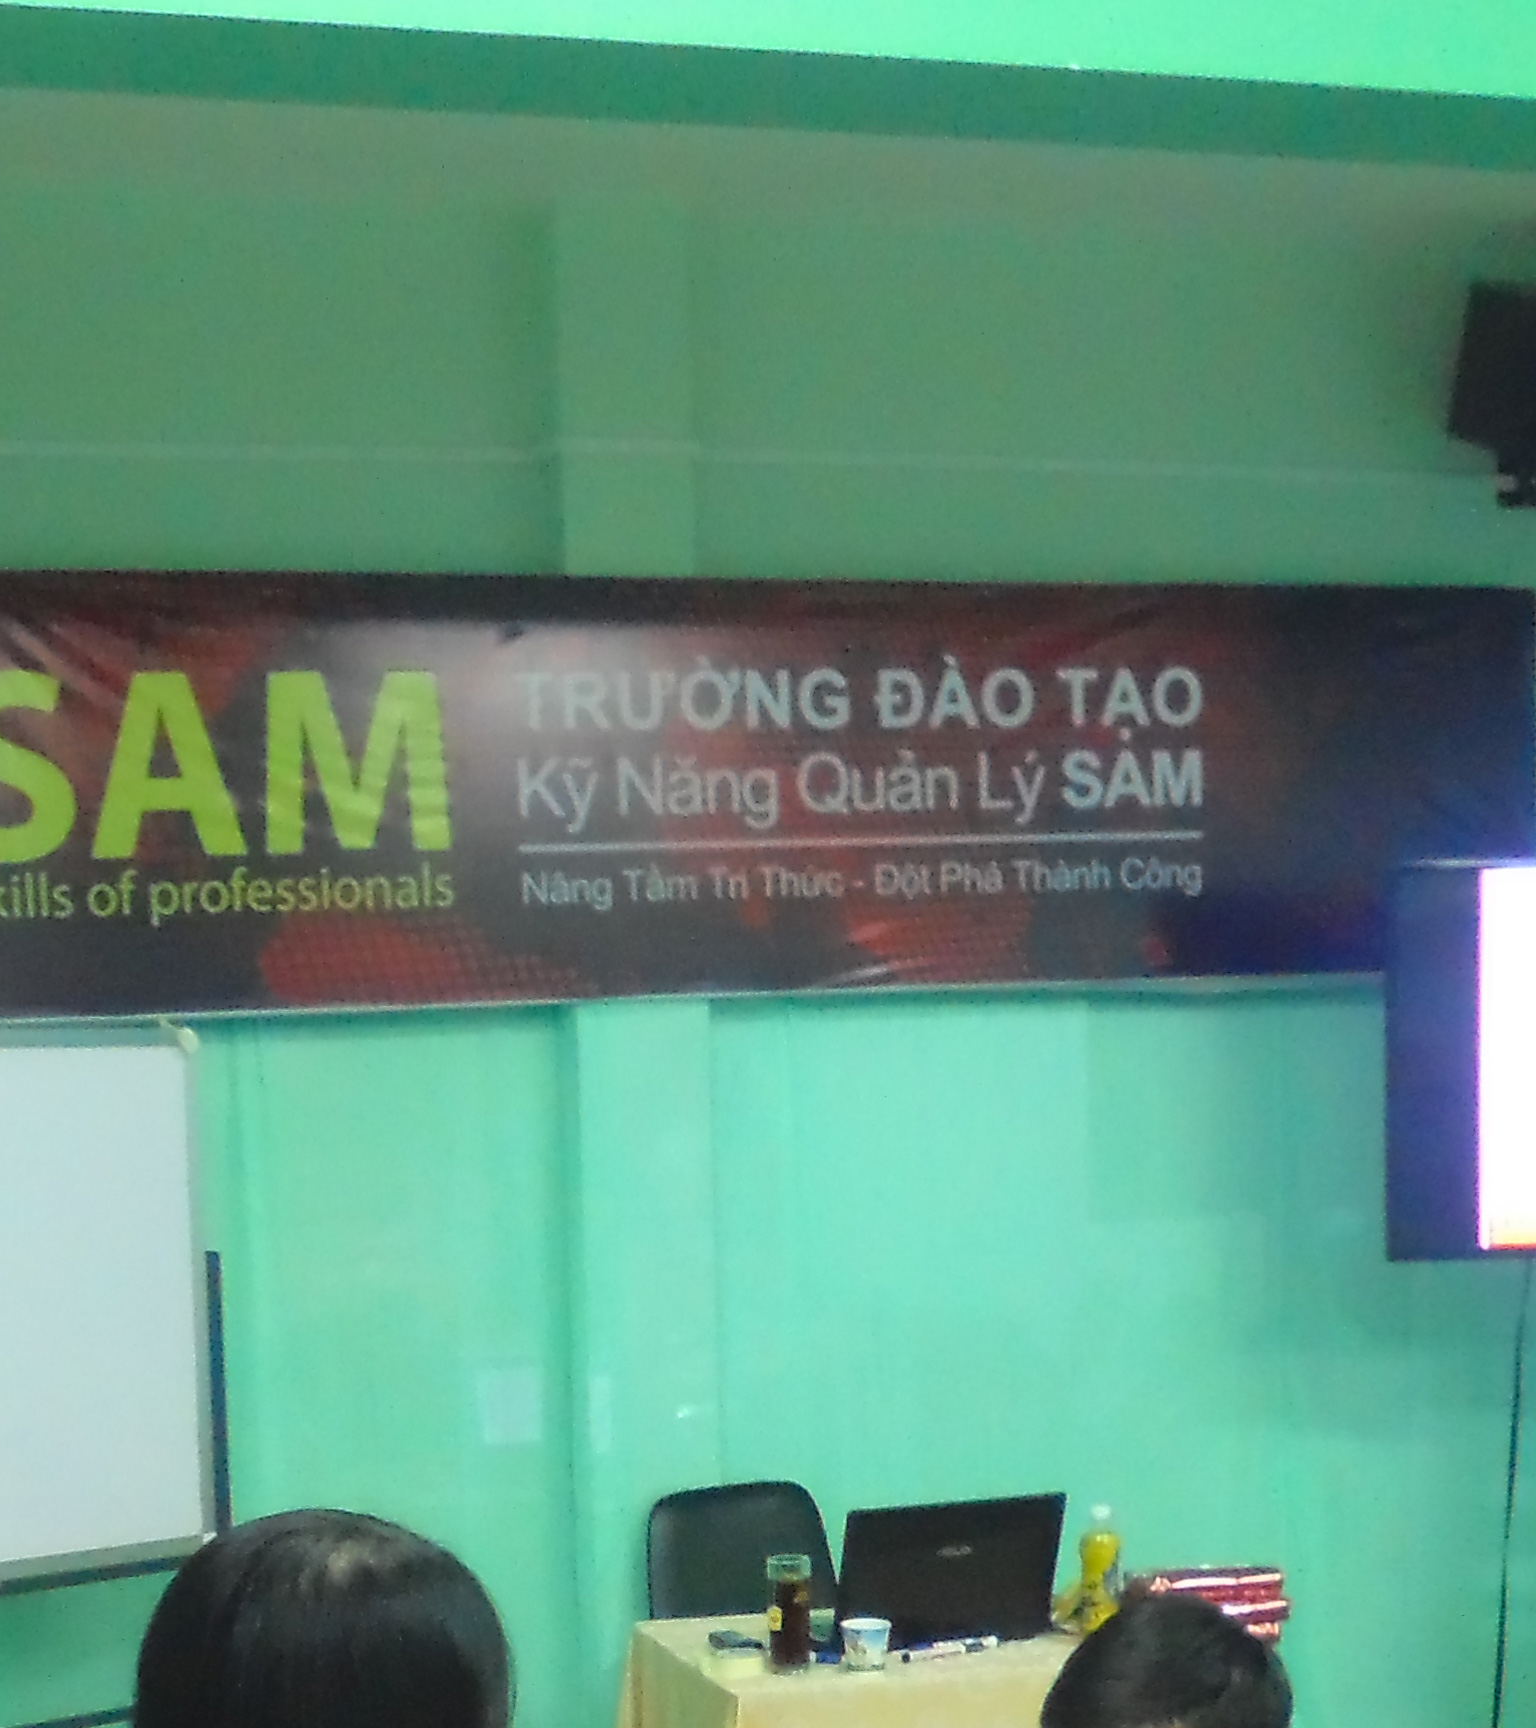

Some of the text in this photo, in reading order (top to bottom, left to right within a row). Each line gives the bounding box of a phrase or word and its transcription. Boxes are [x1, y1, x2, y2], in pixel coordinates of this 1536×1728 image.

[515, 654, 1203, 741] TRƯỜNG ĐÀO TẠO
[517, 748, 1203, 834] Kỹ Năng Quản Lý SAM
[86, 868, 140, 918] of
[149, 861, 457, 928] professionals
